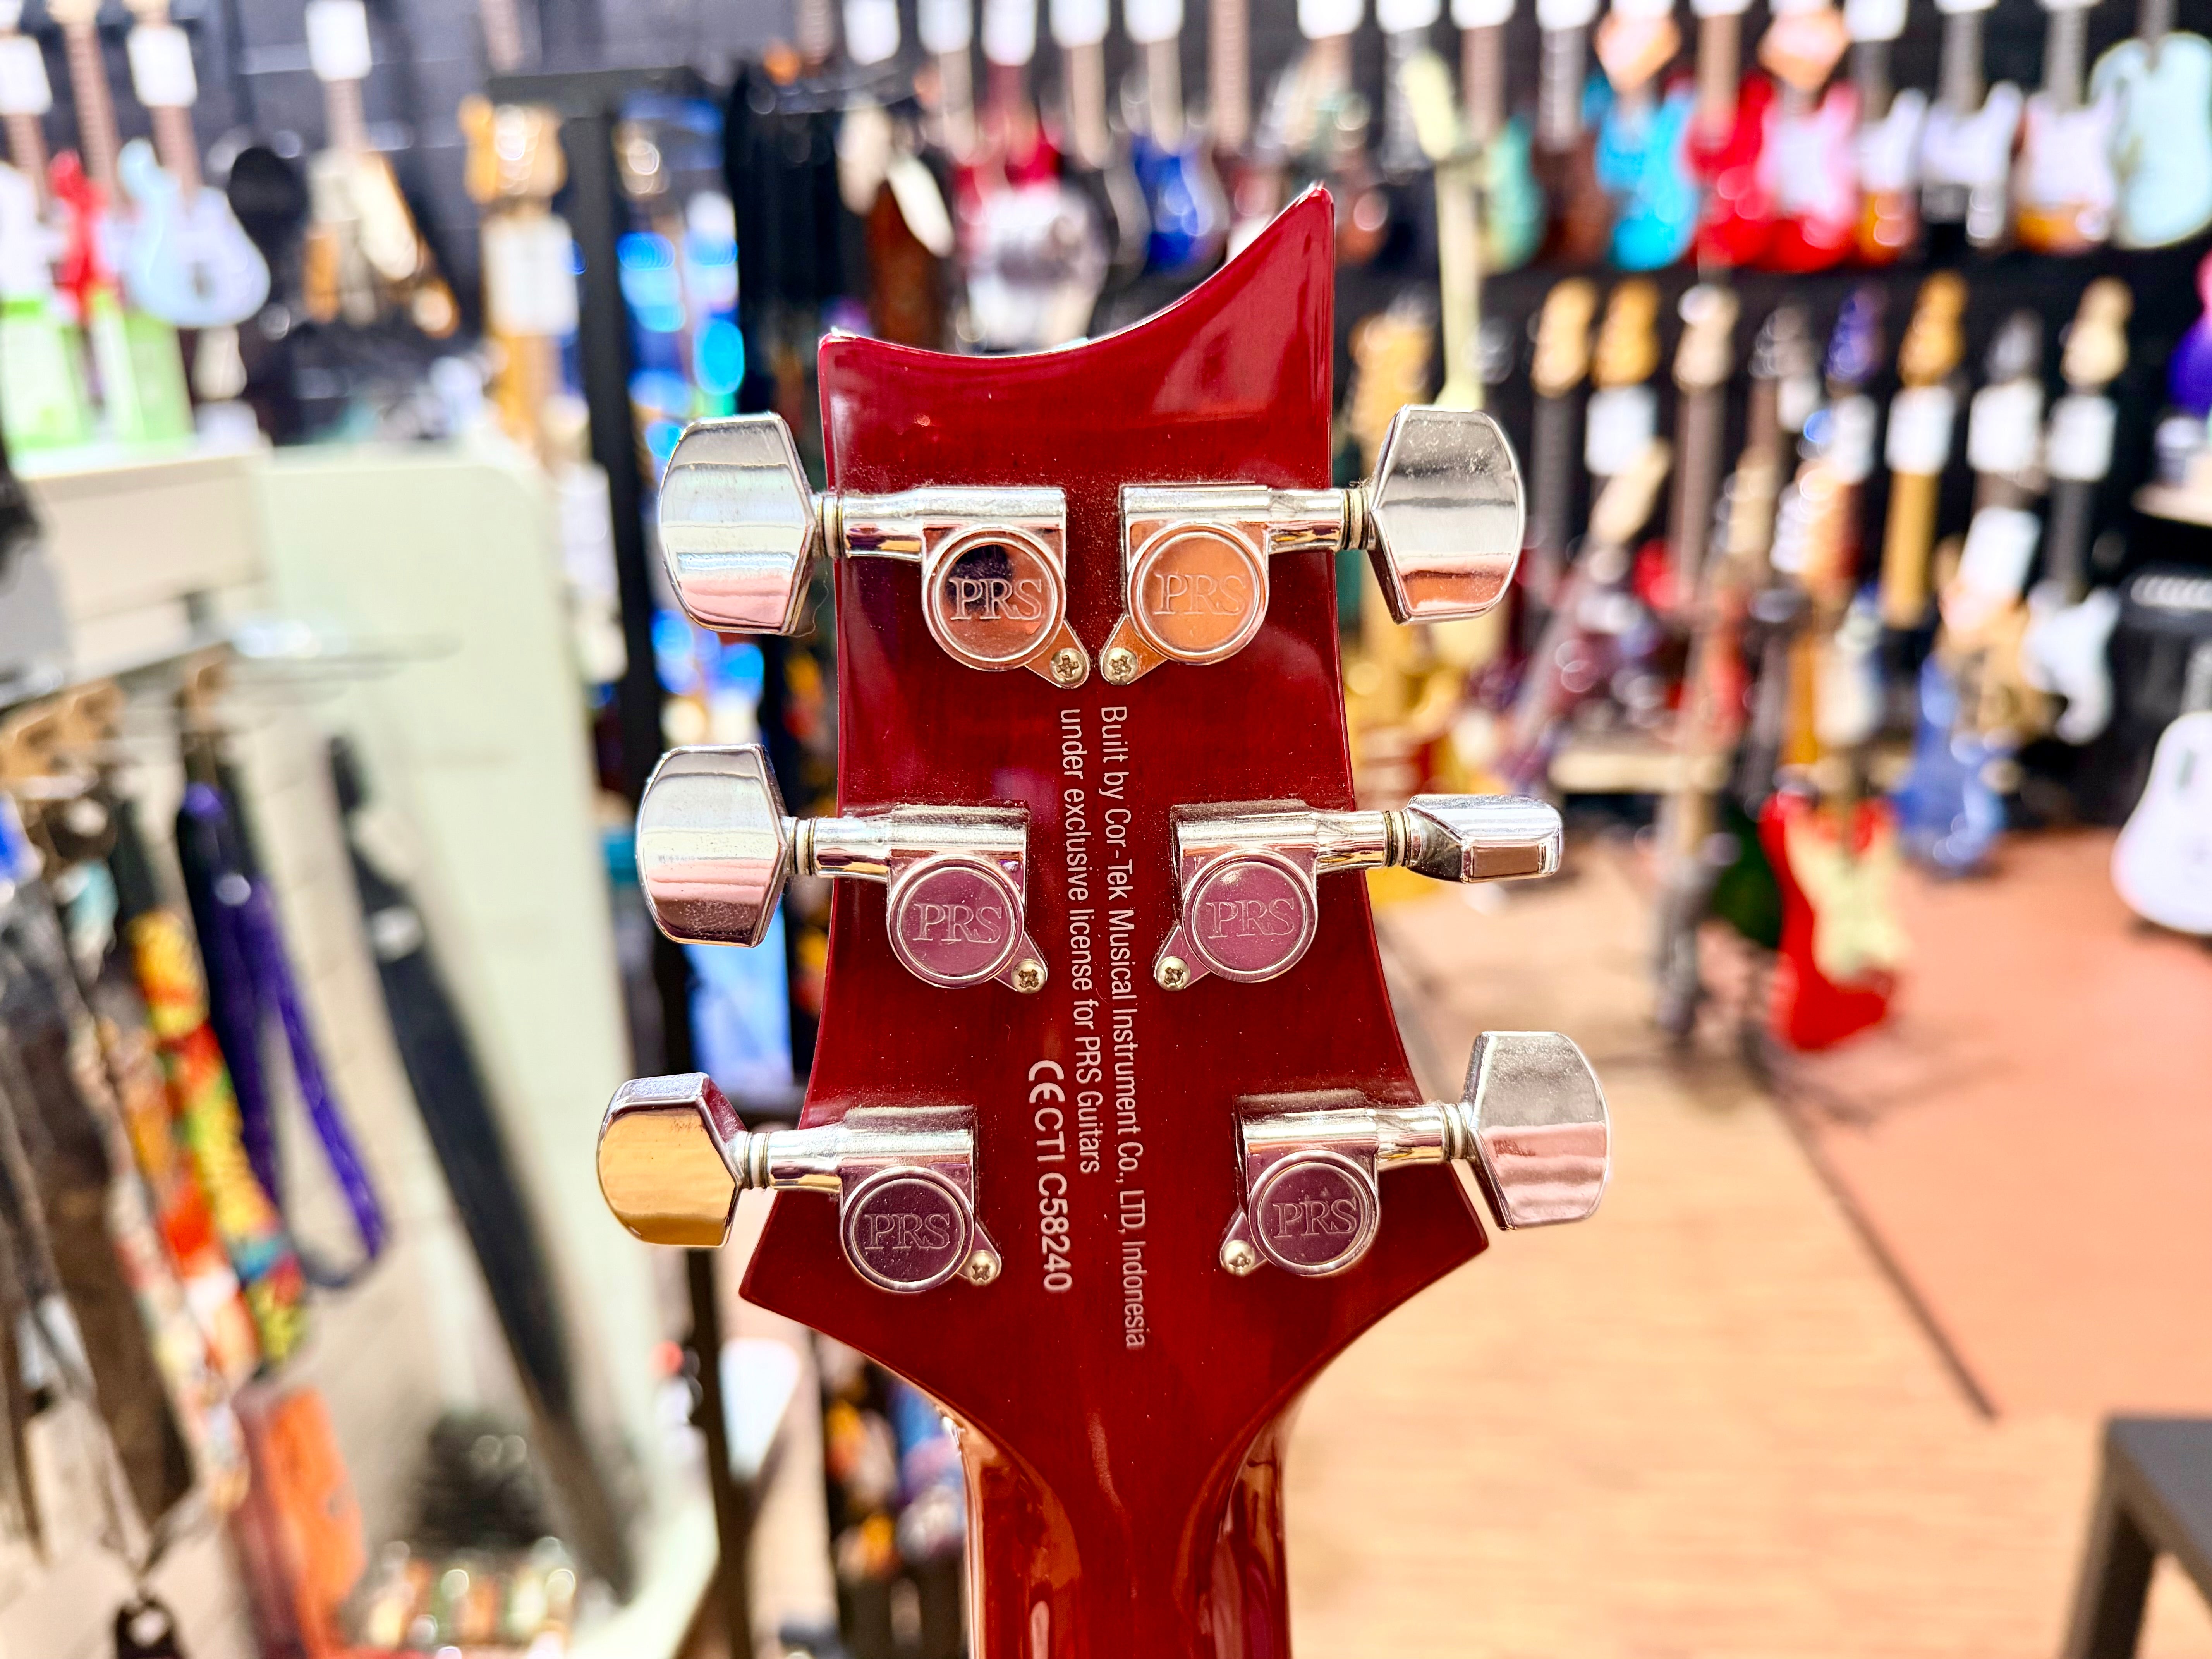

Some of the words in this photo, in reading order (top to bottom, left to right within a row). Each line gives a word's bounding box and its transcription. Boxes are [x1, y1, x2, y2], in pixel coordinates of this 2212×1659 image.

[949, 578, 1042, 620] PRS
[1153, 573, 1245, 616] PRS
[1060, 709, 1088, 780] under
[1101, 706, 1128, 763] Built
[1098, 771, 1130, 800] by
[1063, 788, 1092, 901] exclusive
[1104, 808, 1133, 900] Cor-Tek
[913, 903, 1002, 944] PRS
[1205, 898, 1294, 938] PRS
[1069, 908, 1095, 991] license
[1108, 909, 1137, 1000] Musical
[1073, 998, 1099, 1030] for
[1075, 1036, 1103, 1084] PRS
[1112, 1008, 1142, 1135] Instrument
[1077, 1091, 1103, 1173] Guitars
[1115, 1142, 1144, 1183] Co.,
[864, 1213, 950, 1249] PRS
[1038, 1172, 1073, 1291] C58240
[1118, 1190, 1146, 1233] LTD,
[1272, 1196, 1357, 1238] PRS
[1122, 1241, 1149, 1347] Indonesia
